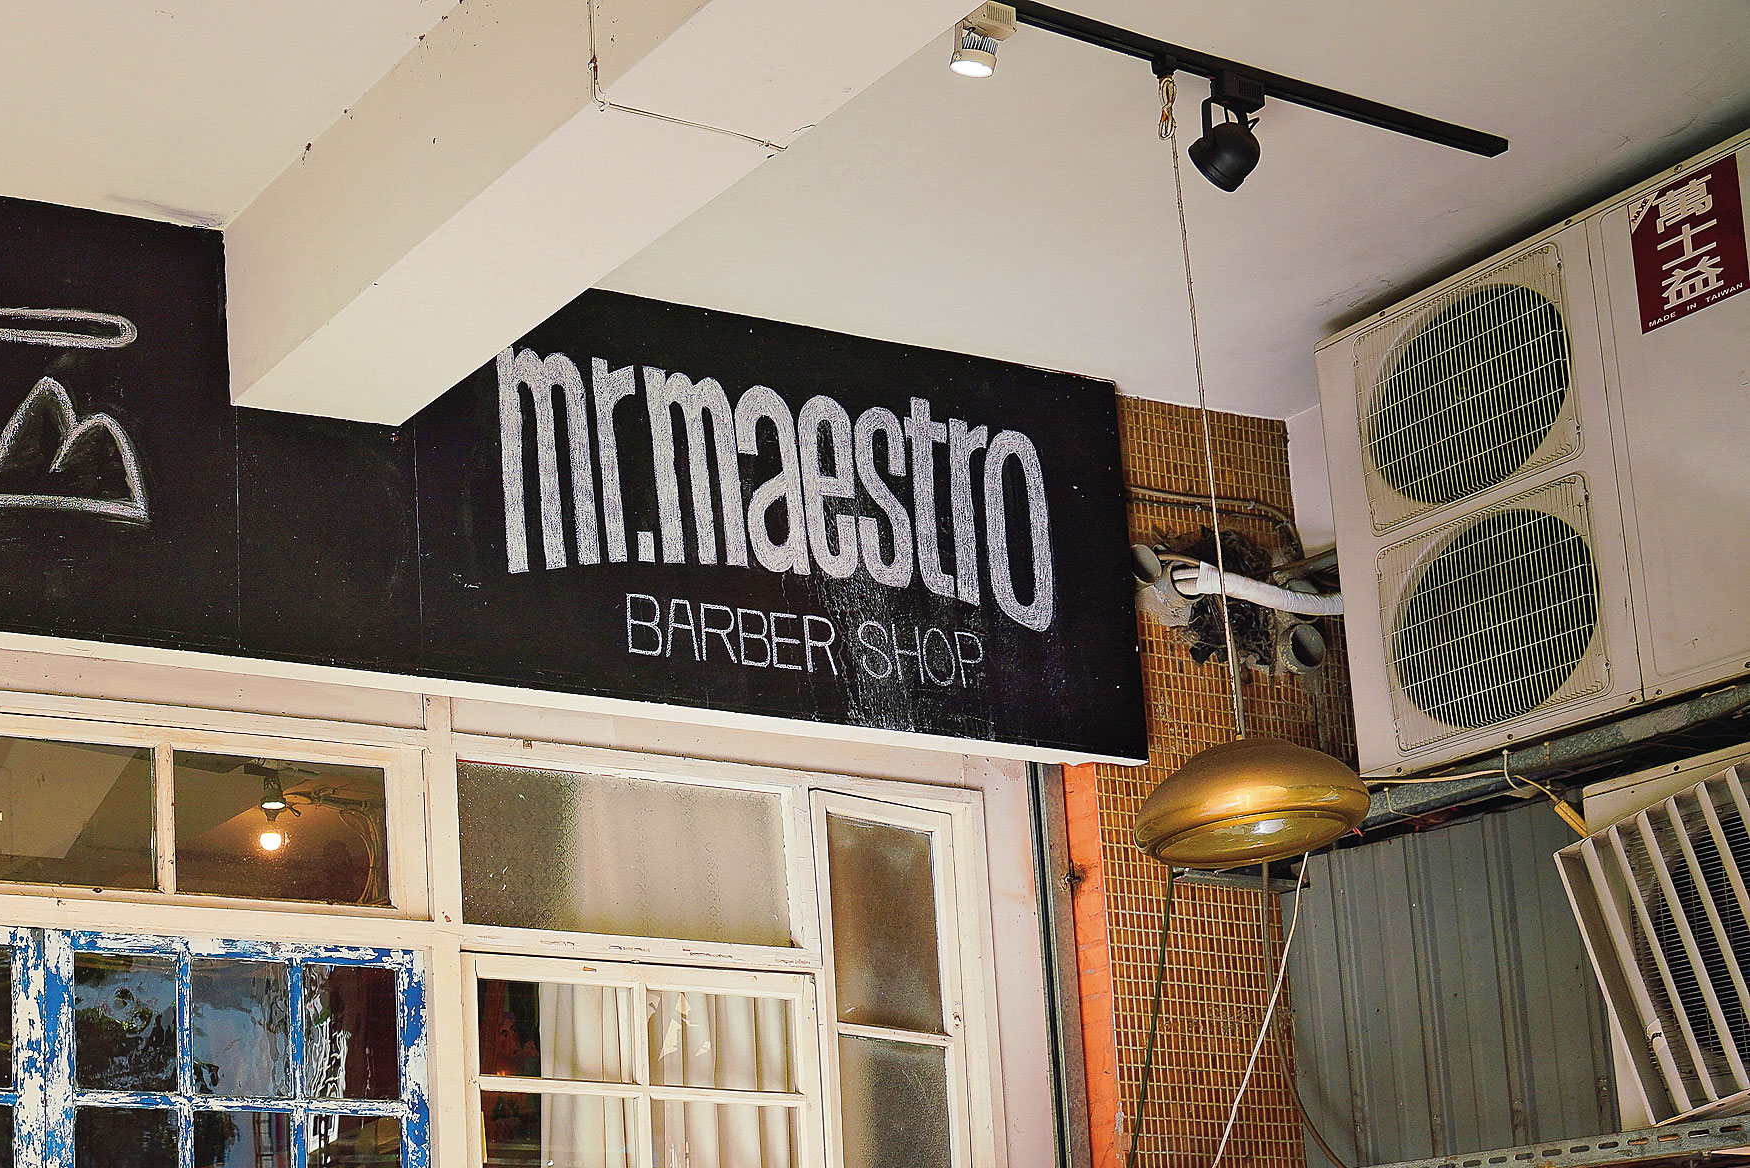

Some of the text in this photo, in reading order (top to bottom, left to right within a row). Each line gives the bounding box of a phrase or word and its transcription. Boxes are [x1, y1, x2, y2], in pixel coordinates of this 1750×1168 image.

[1652, 173, 1724, 310] 萬士益
[1648, 282, 1743, 328] MADE IN TAIWAN
[496, 346, 1053, 632] mr.maestro
[625, 592, 984, 689] BARBER SHOP
